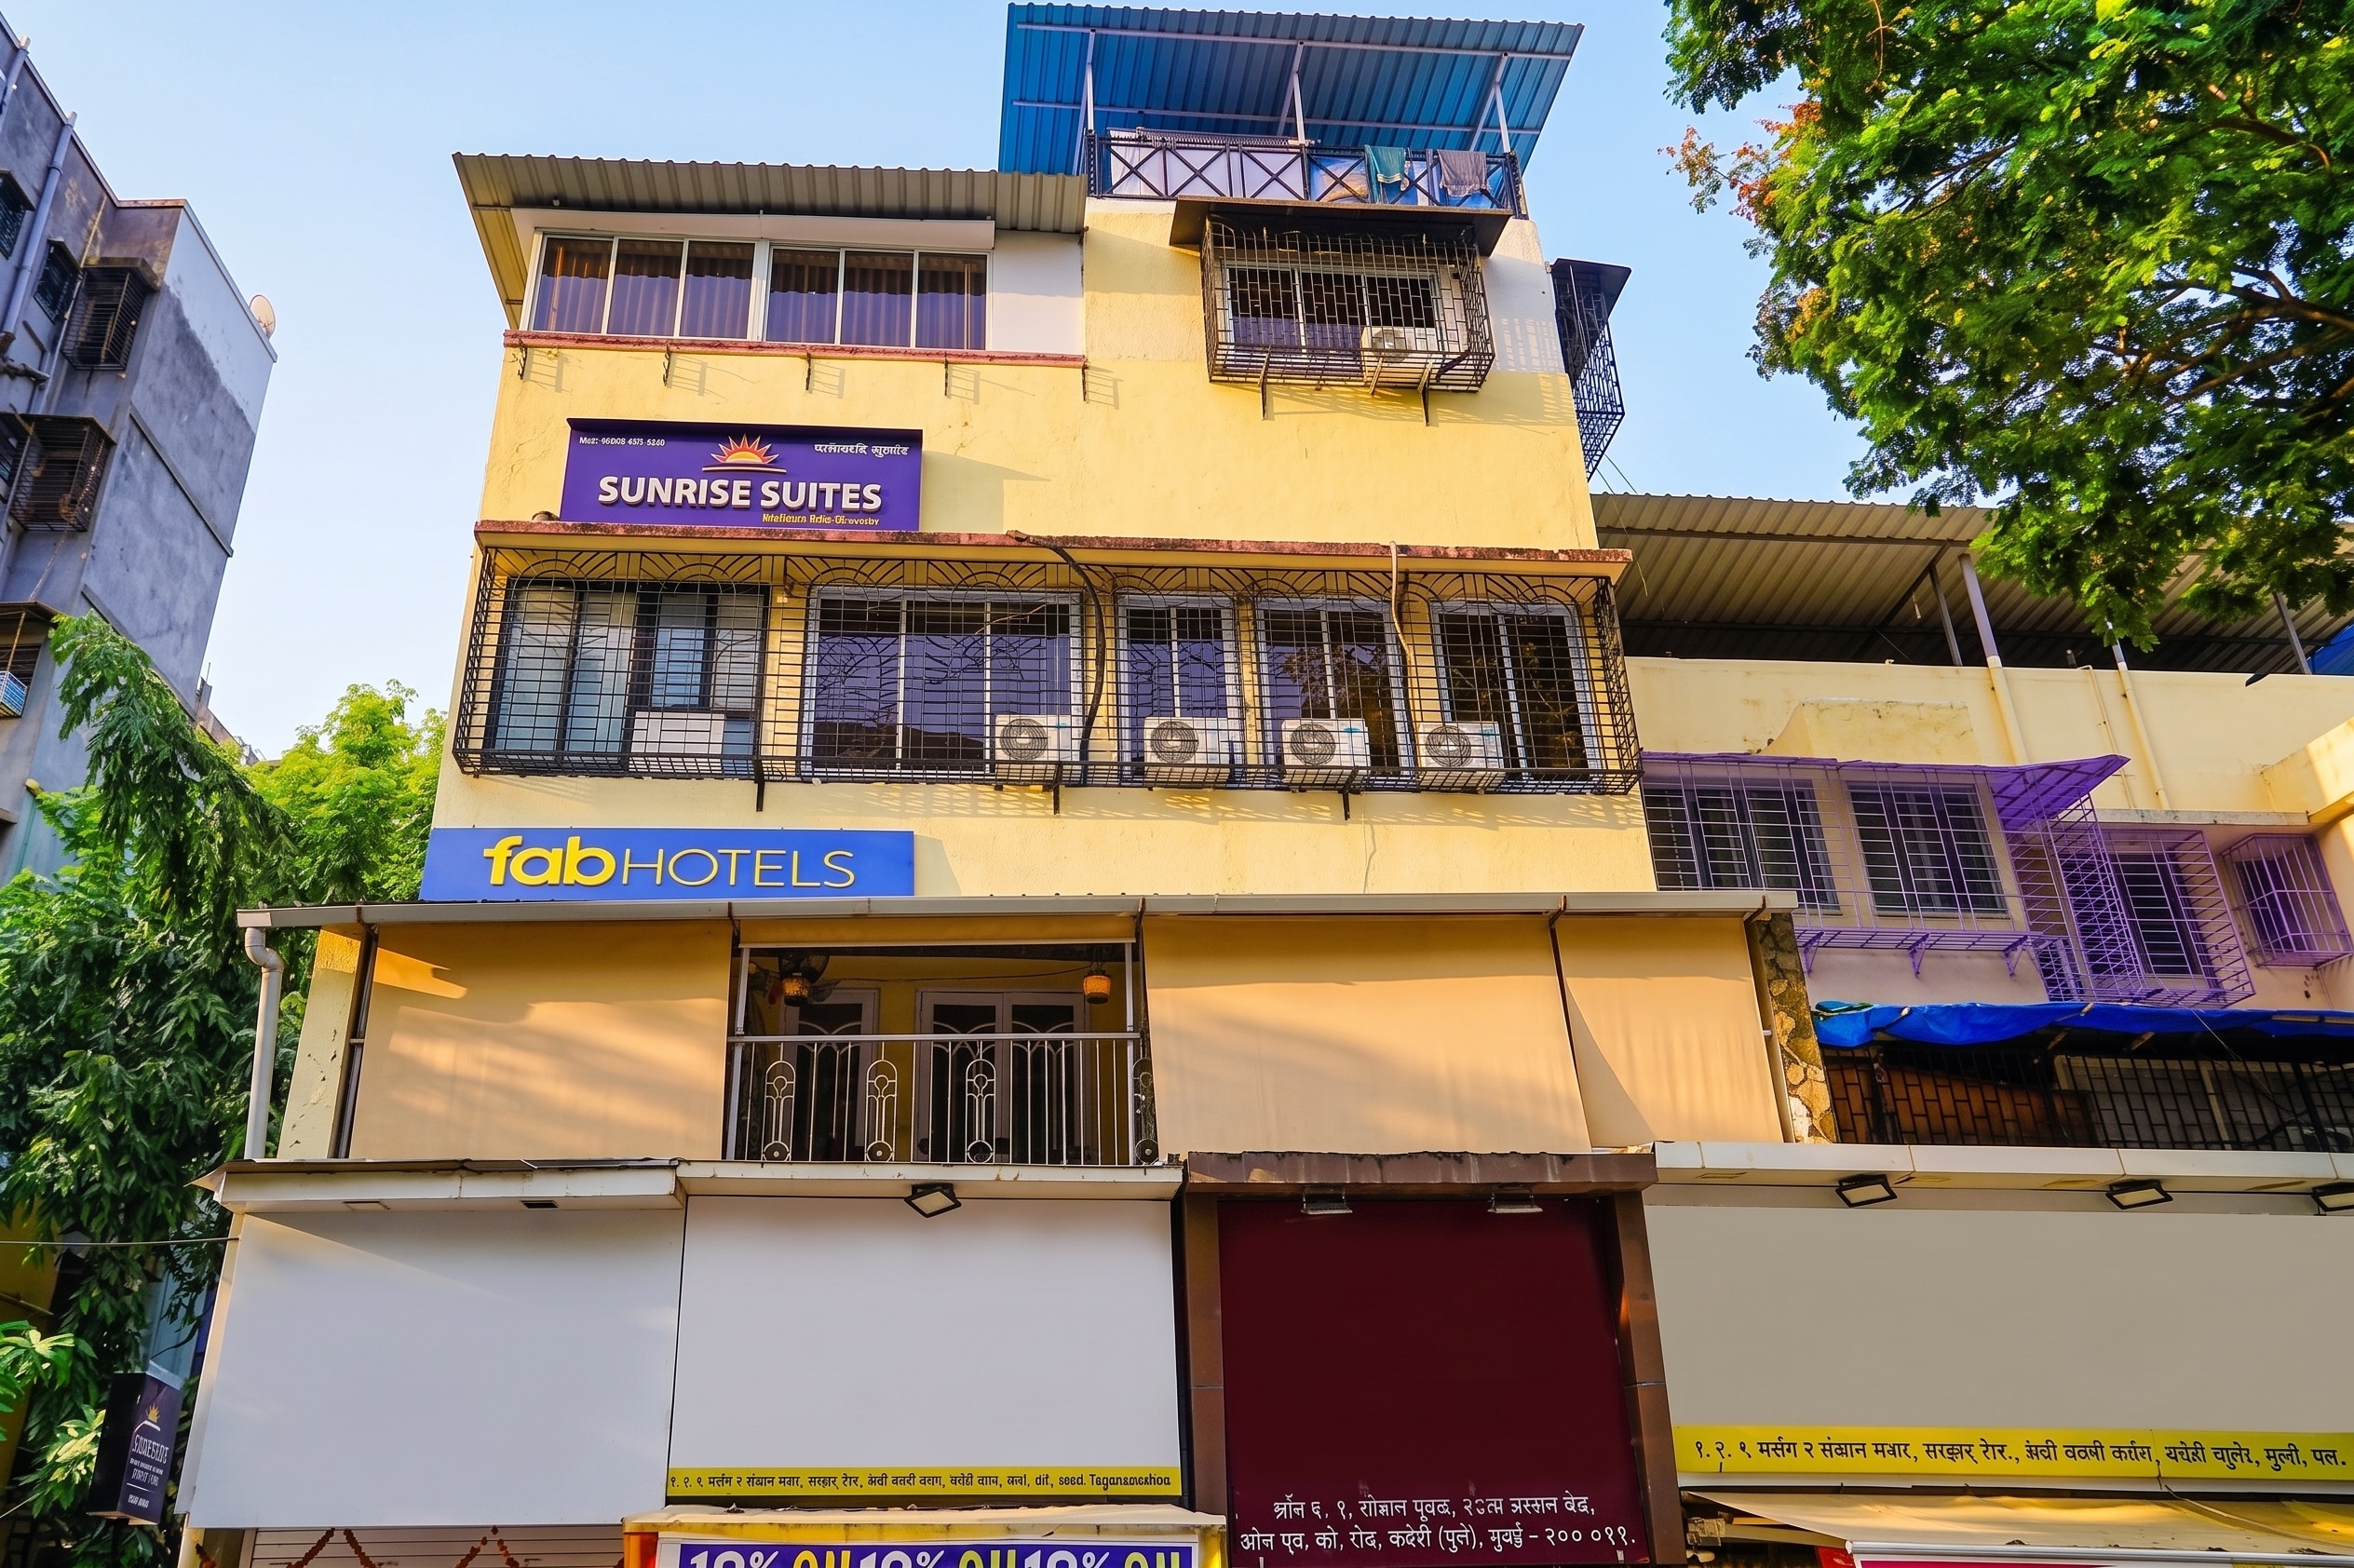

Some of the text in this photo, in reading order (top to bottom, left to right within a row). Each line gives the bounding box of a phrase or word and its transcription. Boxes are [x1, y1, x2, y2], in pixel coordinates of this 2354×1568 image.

[598, 476, 882, 511] SUNRISE SUITES
[1803, 1441, 1814, 1458] २
[1314, 1524, 1344, 1551] को,
